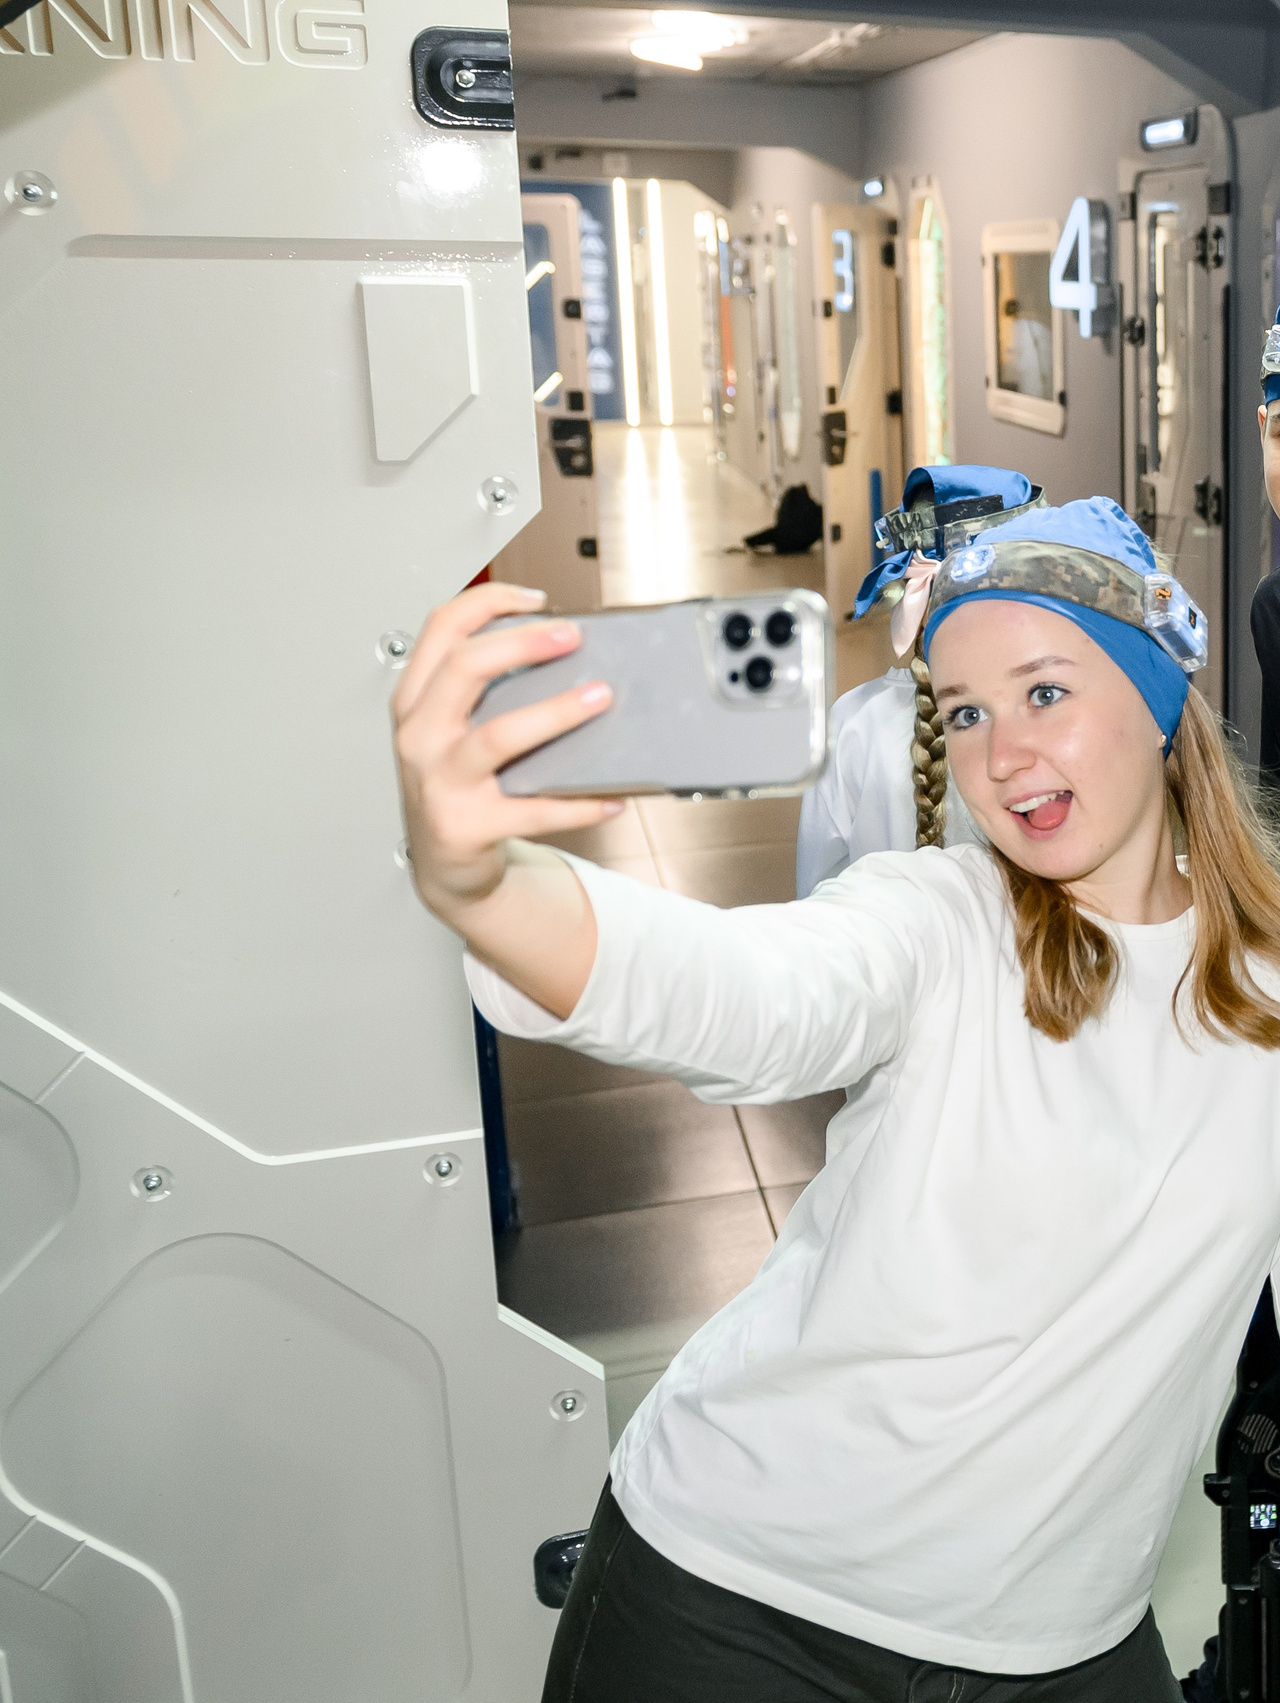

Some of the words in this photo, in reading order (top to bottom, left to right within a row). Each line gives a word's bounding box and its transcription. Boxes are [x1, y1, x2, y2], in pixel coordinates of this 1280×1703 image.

[0, 0, 368, 69] NING
[831, 229, 854, 312] 3
[1049, 196, 1097, 339] 4
